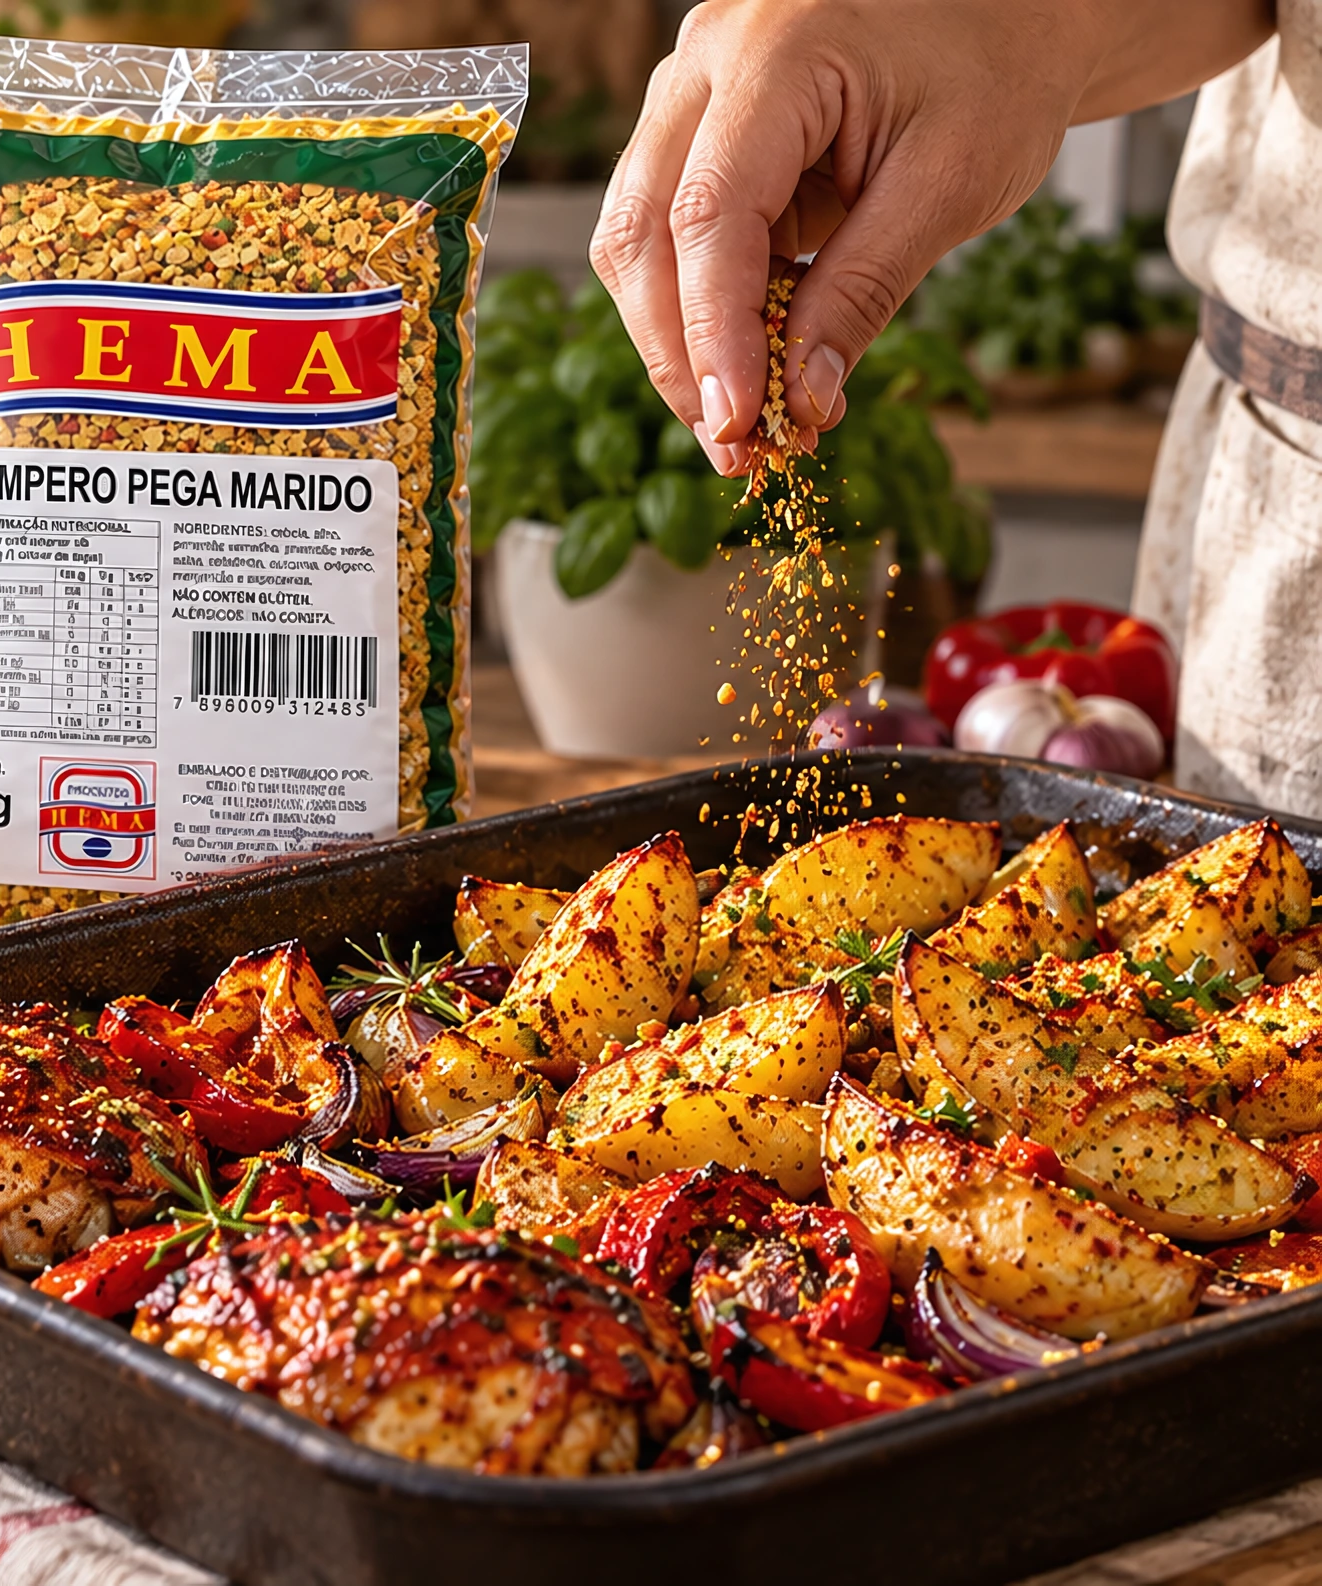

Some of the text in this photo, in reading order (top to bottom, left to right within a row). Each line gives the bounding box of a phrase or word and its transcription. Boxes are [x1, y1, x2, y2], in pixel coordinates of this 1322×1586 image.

[128, 468, 223, 508] PEGA
[230, 471, 373, 513] MARIDO
[173, 696, 183, 710] 7
